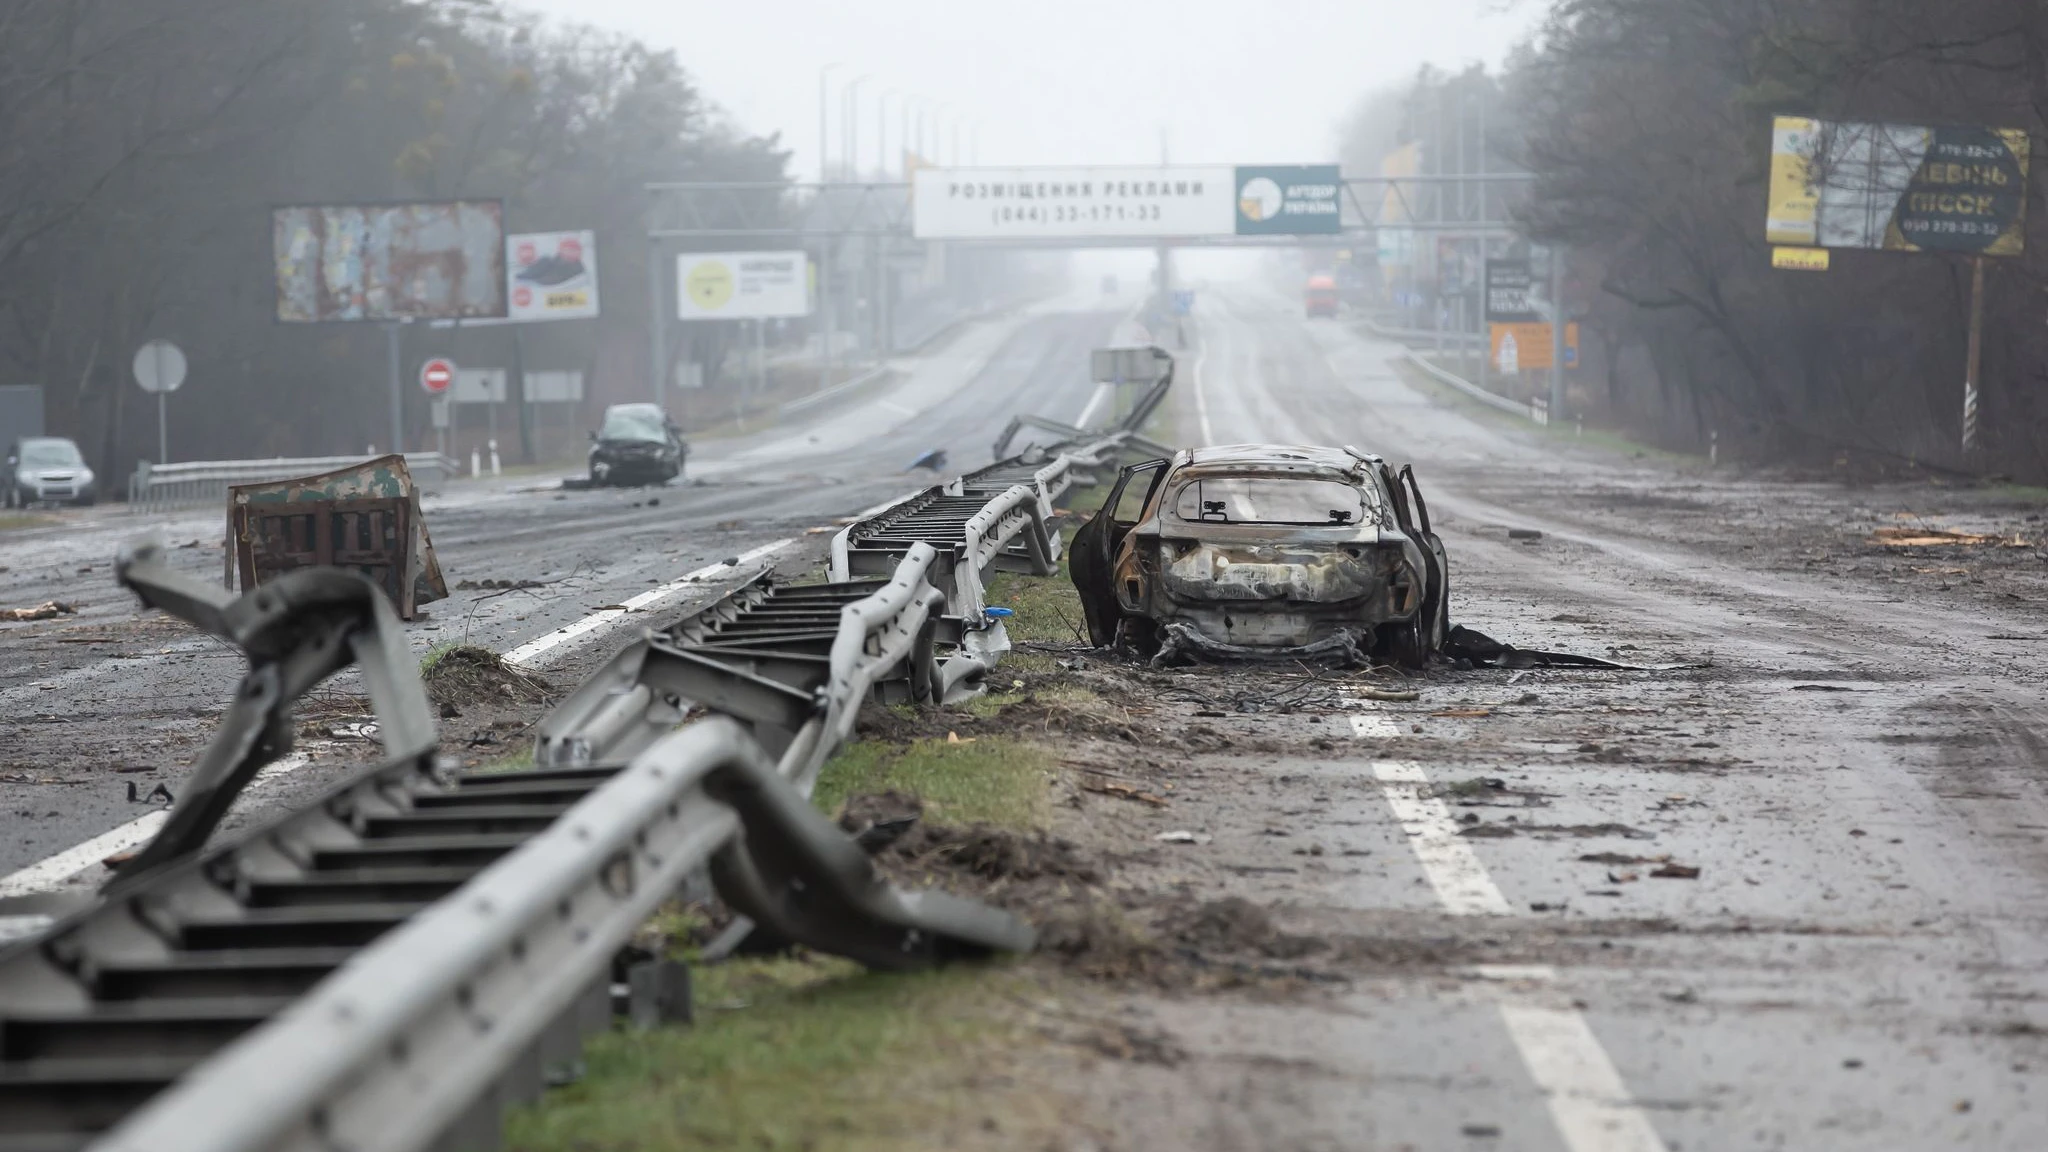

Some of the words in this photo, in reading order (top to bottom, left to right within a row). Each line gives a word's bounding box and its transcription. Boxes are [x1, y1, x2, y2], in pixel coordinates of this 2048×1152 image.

[948, 181, 1093, 200] РОЗМІЩЕННЯ
[1104, 180, 1204, 197] РЕКЛАМИ
[992, 205, 1048, 226] (044)
[1054, 204, 1162, 222] 33-171-33
